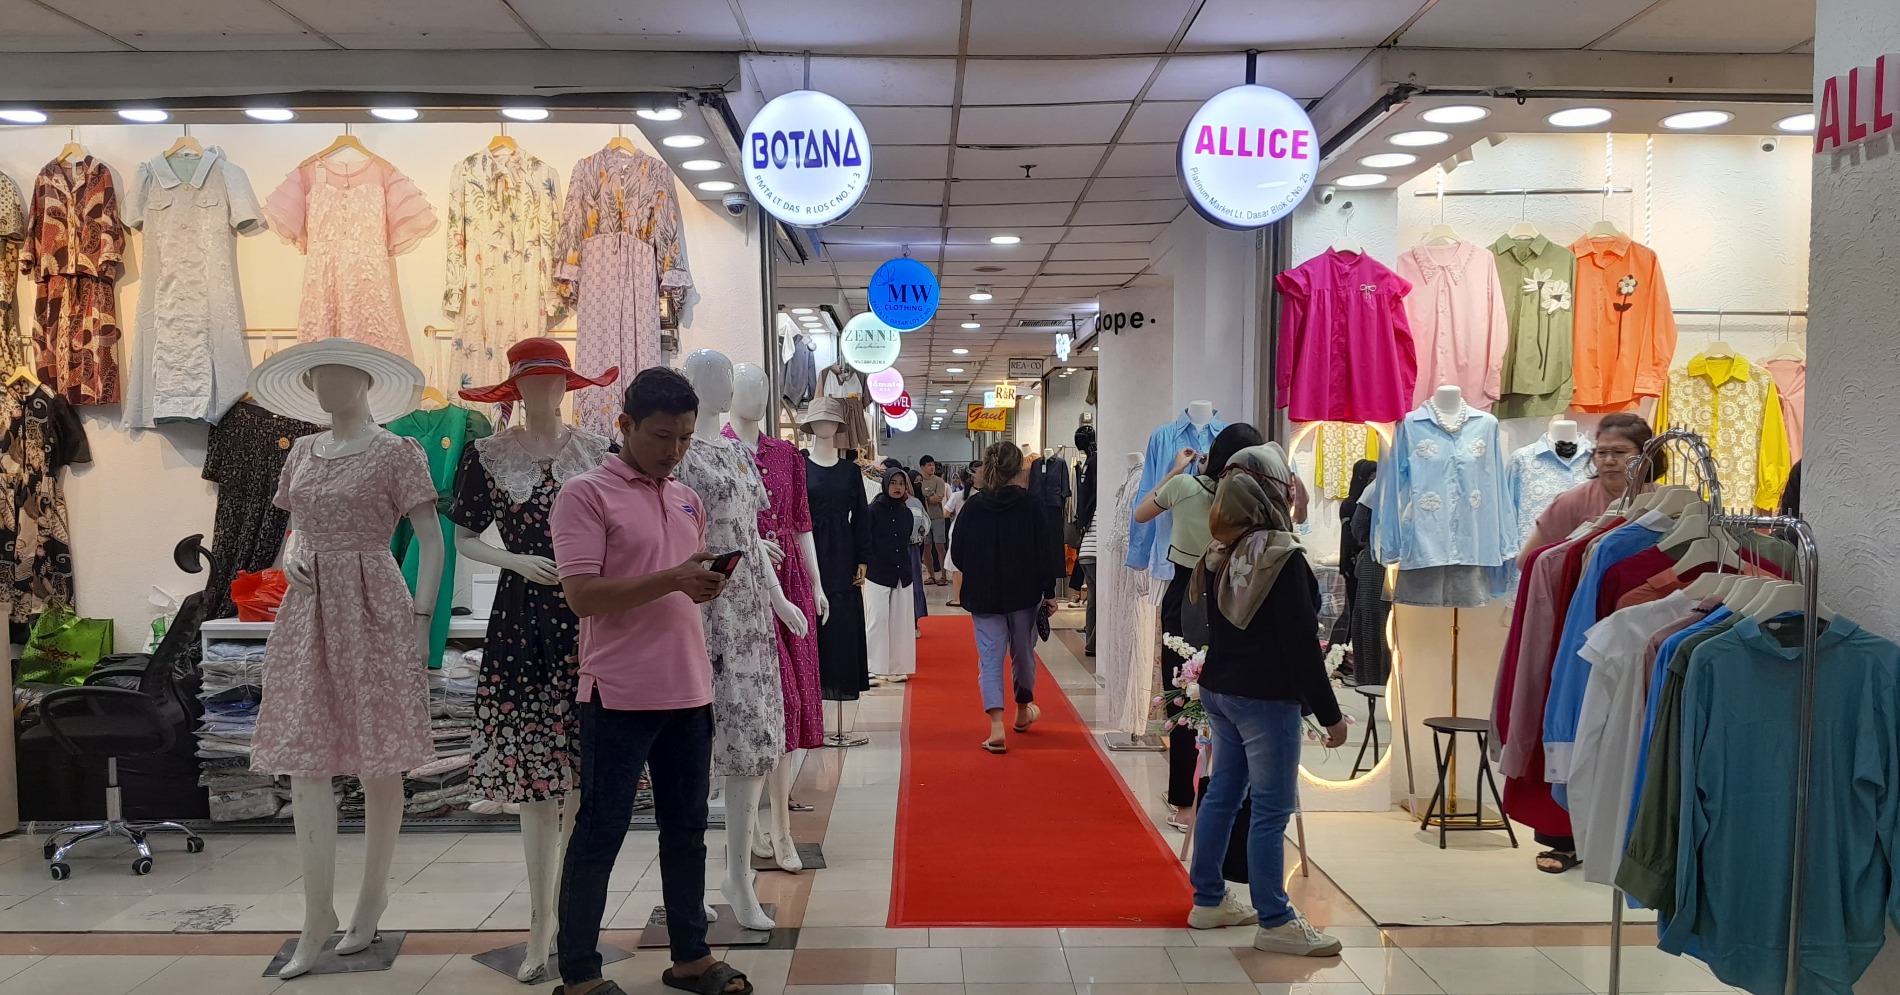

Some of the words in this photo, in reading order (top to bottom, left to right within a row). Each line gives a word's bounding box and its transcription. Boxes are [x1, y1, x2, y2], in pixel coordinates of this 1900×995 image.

[752, 127, 862, 169] BOTANA
[1194, 125, 1309, 160] ALLICE
[754, 174, 773, 199] PMTA
[772, 195, 782, 206] LT.
[813, 202, 829, 213] LOS
[830, 199, 836, 207] C
[1190, 166, 1210, 200] Platinum
[1208, 196, 1233, 216] Market
[1234, 209, 1245, 218] Lt.
[1246, 210, 1269, 219] Dasar
[1270, 201, 1288, 215] Blok
[1286, 194, 1294, 203] C
[1291, 185, 1304, 198] No.
[1299, 172, 1309, 183] 25
[888, 284, 933, 303] MW
[884, 304, 923, 312] CLOTHING
[845, 329, 898, 341] ZENNE
[996, 387, 1015, 400] R&R
[969, 406, 1005, 424] Gaul
